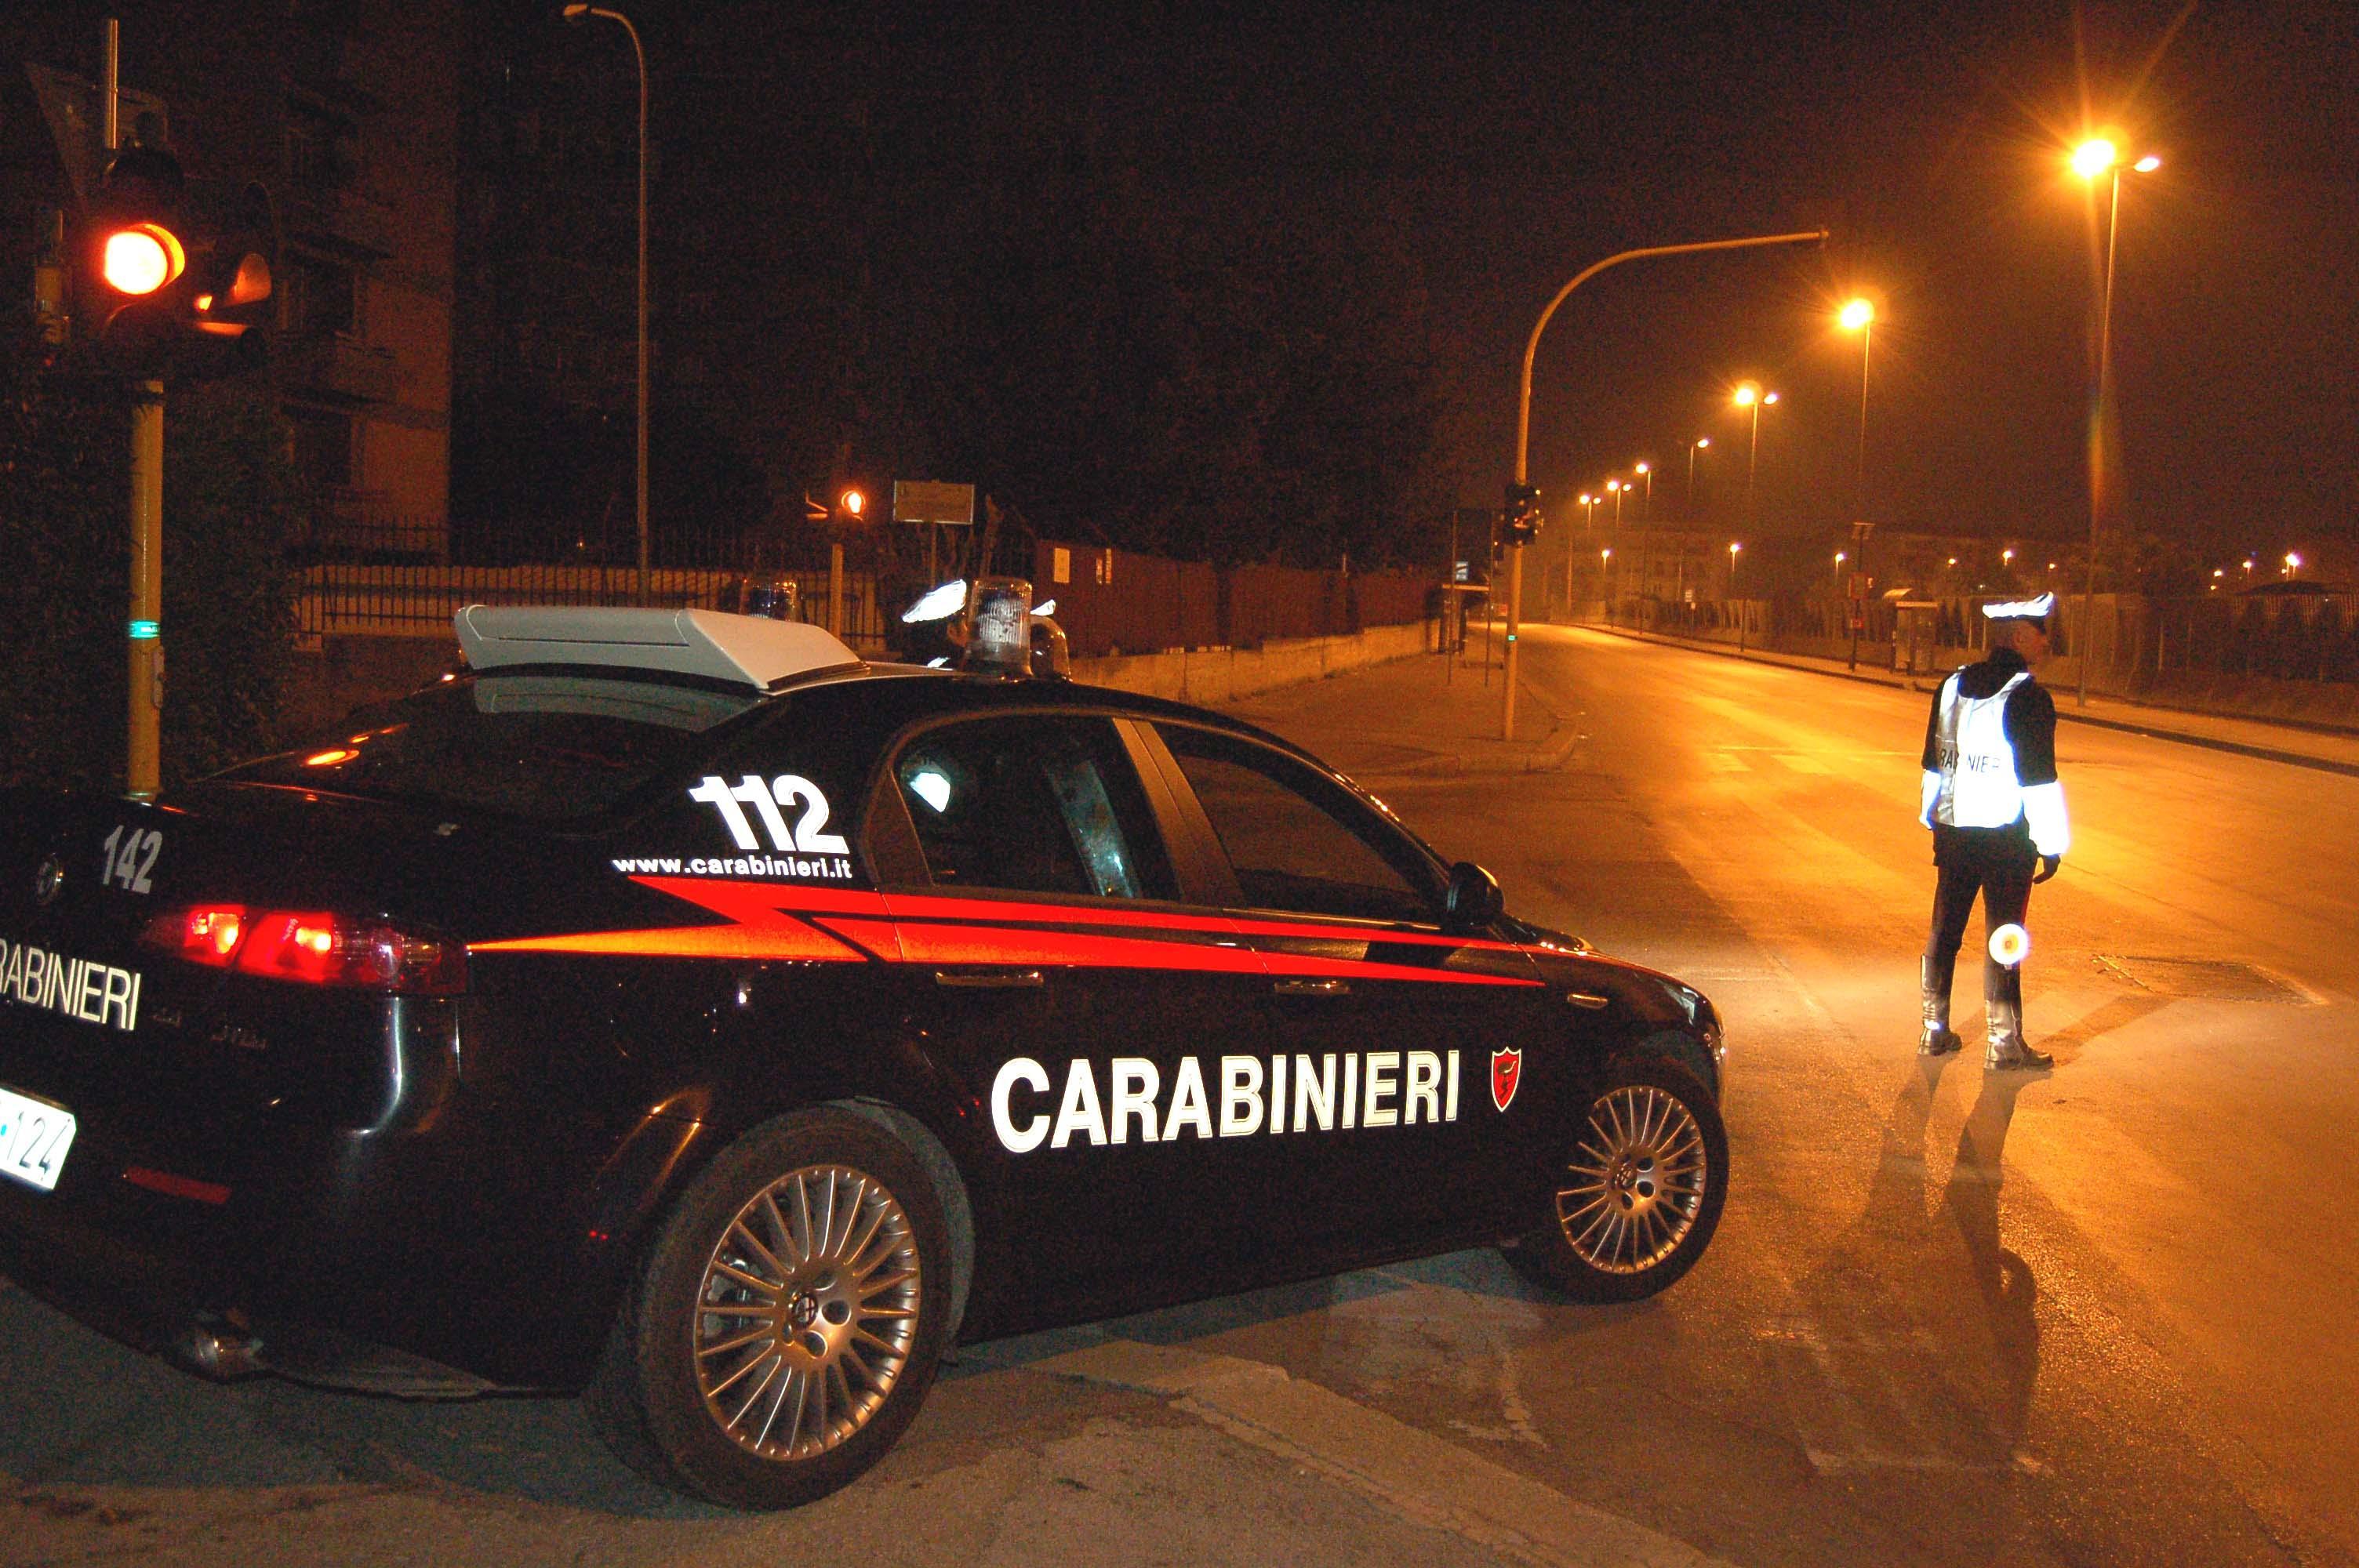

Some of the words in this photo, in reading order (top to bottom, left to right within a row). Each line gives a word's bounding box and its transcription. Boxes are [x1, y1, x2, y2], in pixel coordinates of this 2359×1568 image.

[689, 775, 849, 854] 112
[103, 825, 162, 894] 142
[611, 855, 852, 879] www.carabinieri.it
[991, 1050, 1459, 1152] CARABINIERI
